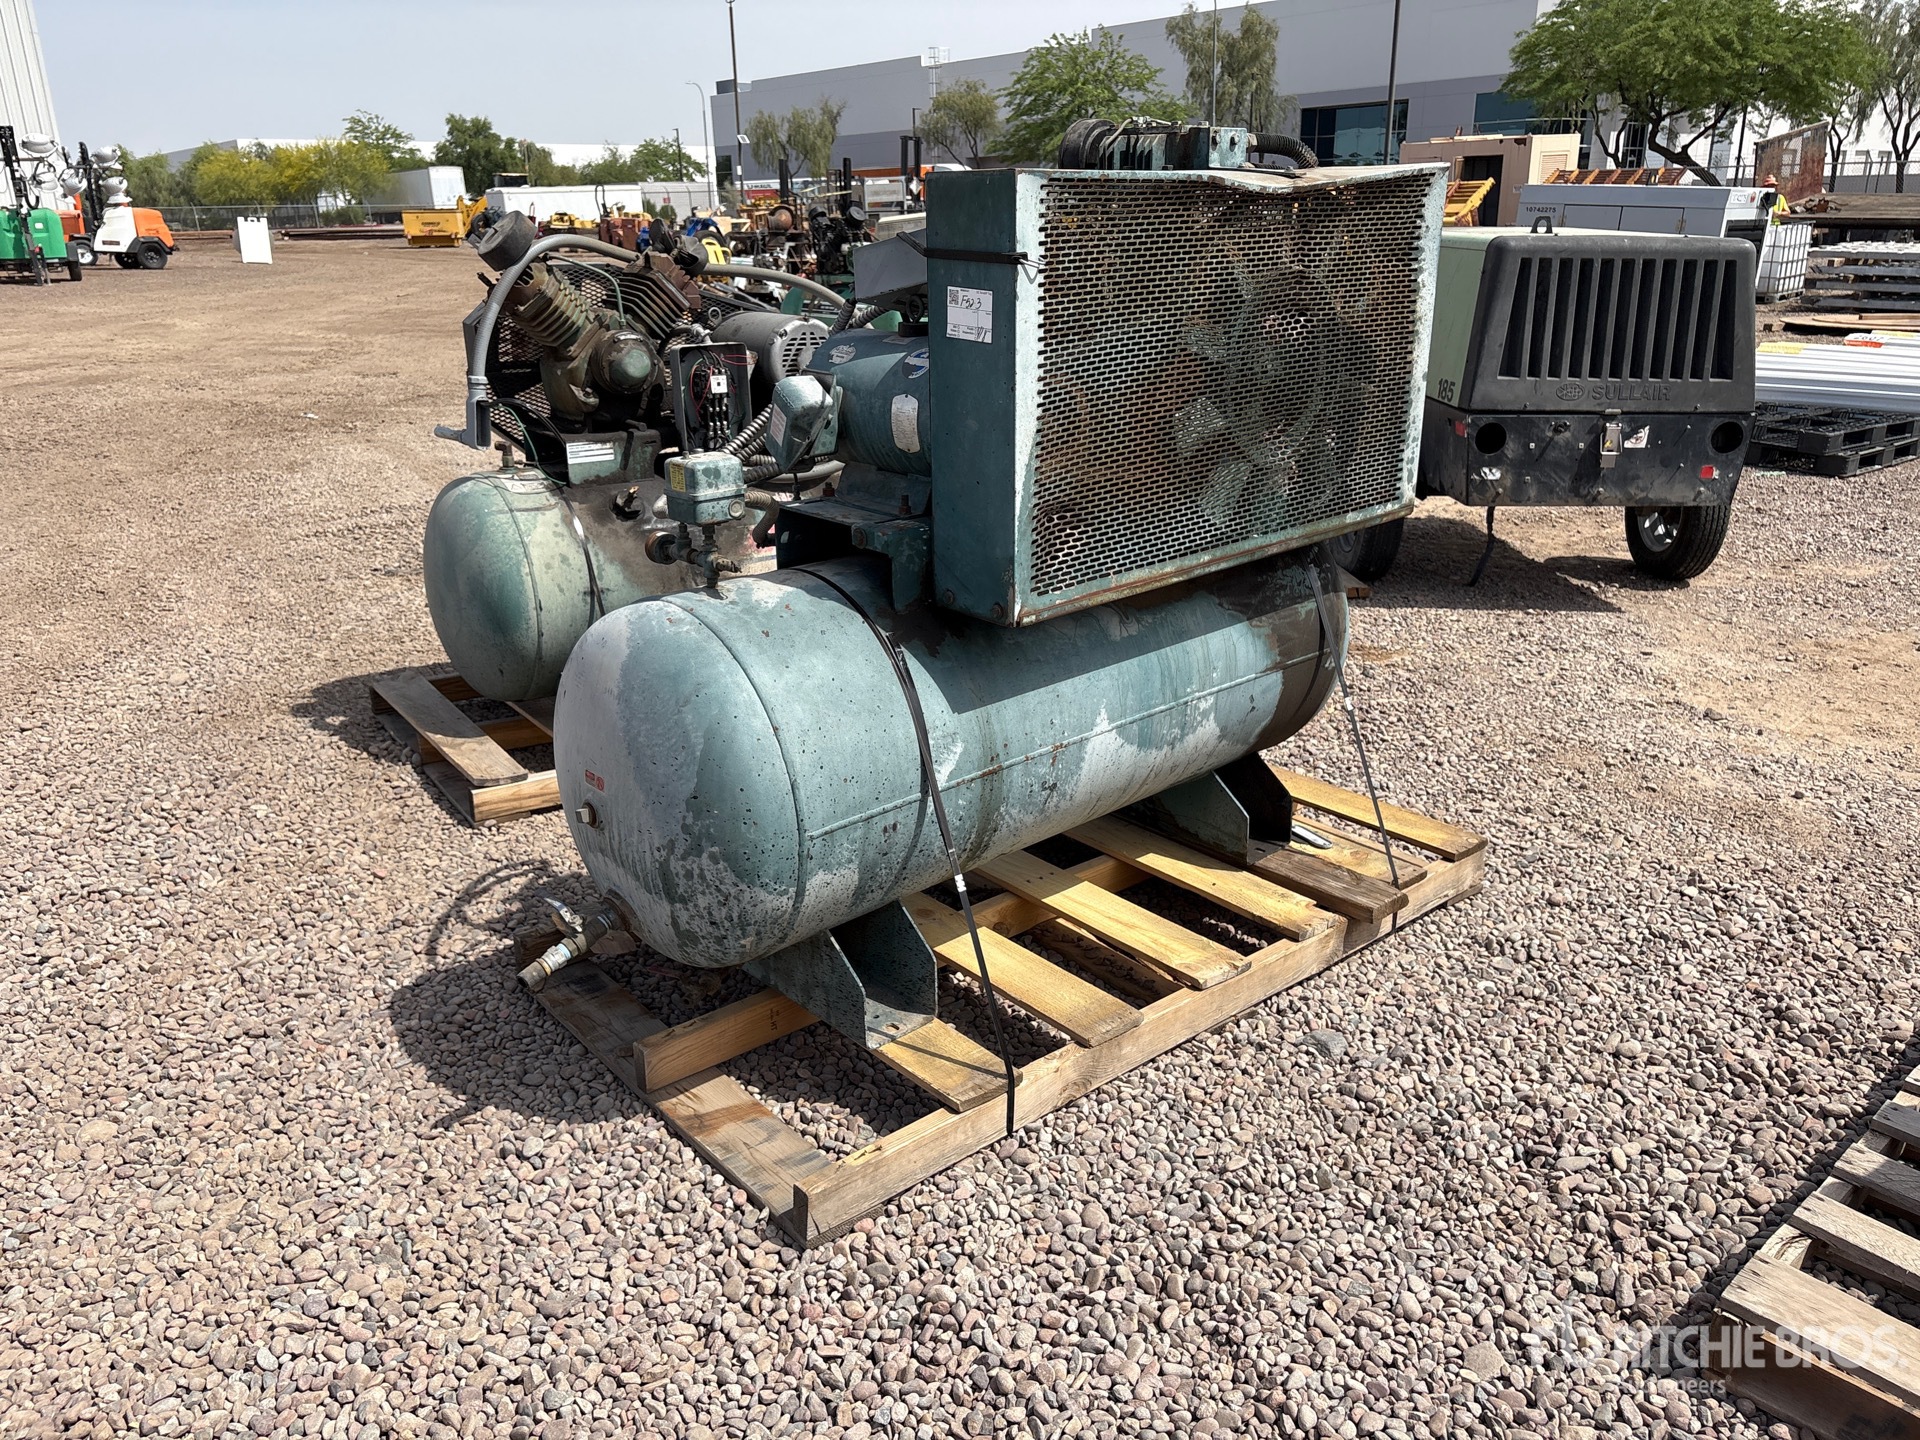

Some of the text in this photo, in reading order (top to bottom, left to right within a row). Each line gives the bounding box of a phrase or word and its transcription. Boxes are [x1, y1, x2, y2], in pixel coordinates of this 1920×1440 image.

[1525, 206, 1557, 214] 10742275
[1437, 378, 1456, 403] 185
[1591, 383, 1672, 401] SULLAIR
